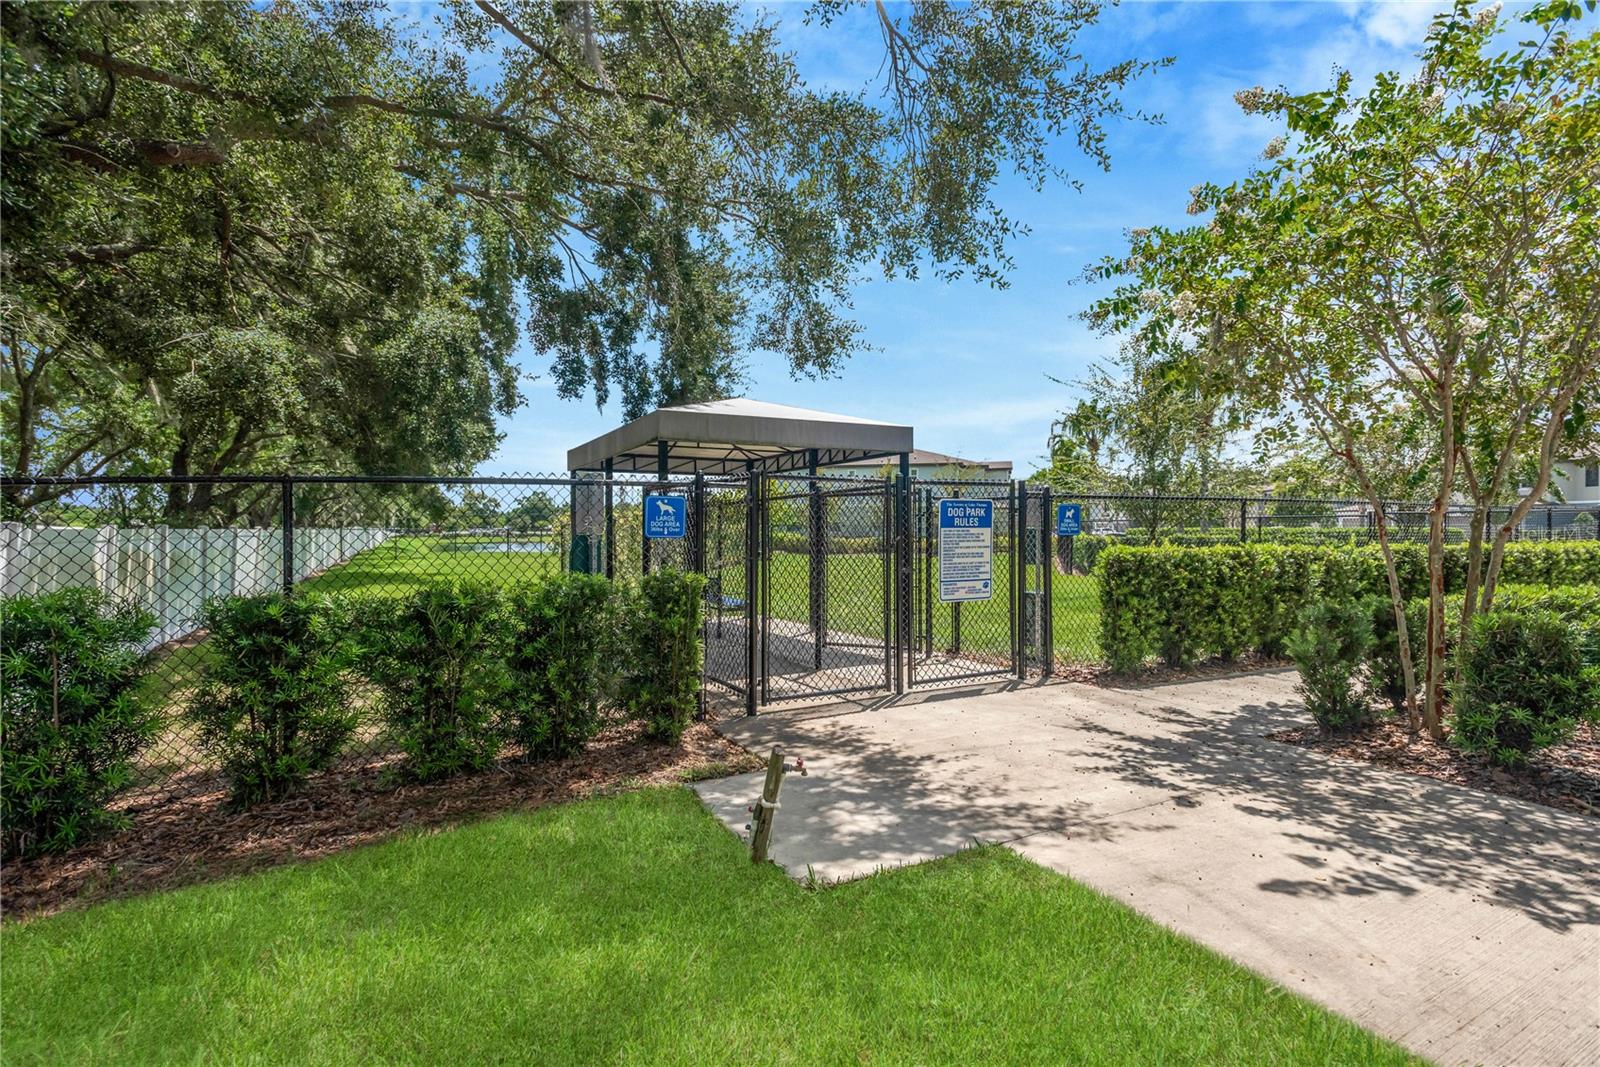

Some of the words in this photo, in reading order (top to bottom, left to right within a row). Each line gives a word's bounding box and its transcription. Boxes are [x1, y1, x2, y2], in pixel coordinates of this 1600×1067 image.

[947, 508, 964, 517] DOG
[966, 508, 986, 517] PARK
[954, 518, 979, 526] RULES
